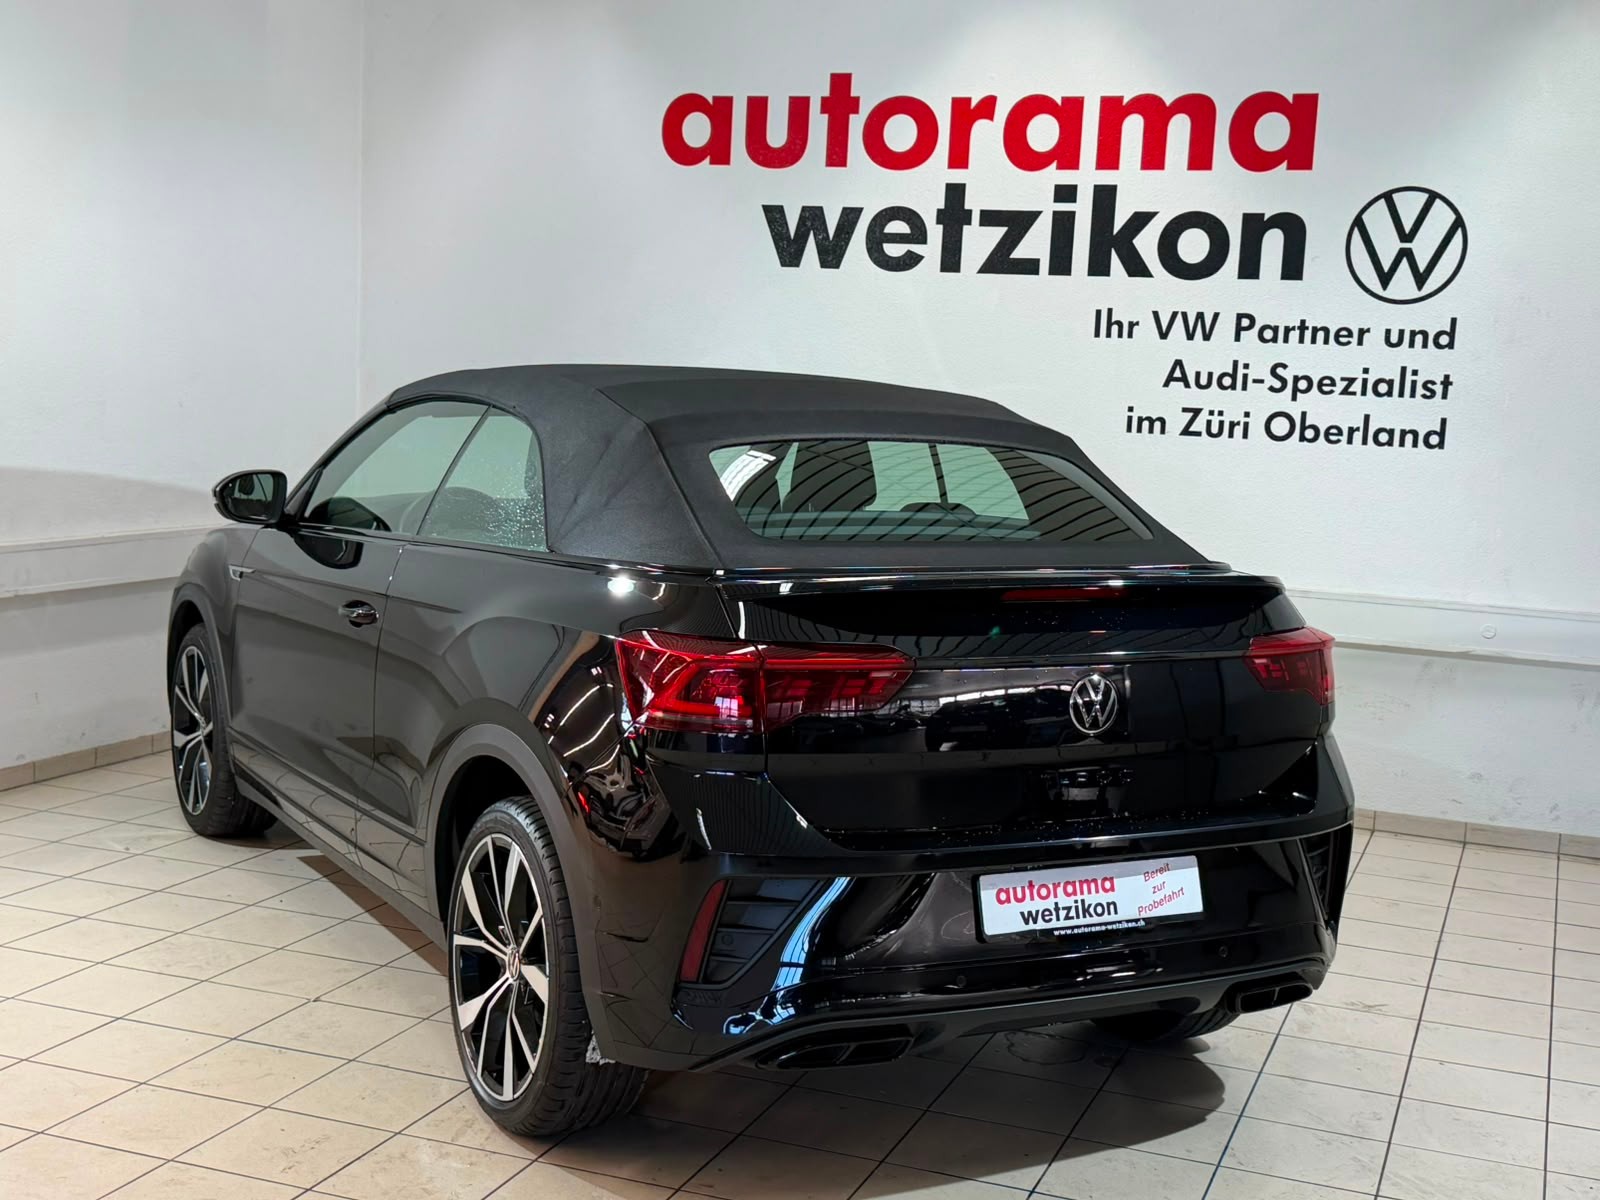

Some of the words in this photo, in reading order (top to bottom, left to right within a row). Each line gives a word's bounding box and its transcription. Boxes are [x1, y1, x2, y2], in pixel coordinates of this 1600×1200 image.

[662, 73, 1319, 172] autorama
[762, 183, 1306, 280] wetzikon
[1094, 308, 1139, 338] Ihr
[1152, 311, 1220, 341] VW
[1235, 313, 1370, 346] Partner
[1385, 317, 1457, 350] und
[1163, 358, 1453, 401] Audi-Spezialist
[1127, 406, 1166, 434] im
[1179, 407, 1250, 440] Züri
[1265, 411, 1447, 449] Oberland
[1143, 862, 1171, 882] Bereit
[995, 876, 1115, 905] autorama
[1137, 887, 1185, 916] Probefahrt
[1152, 880, 1166, 894] zur
[1020, 899, 1118, 926] wetzikon
[1053, 918, 1146, 936] www.autorama-wetzikon.ch
